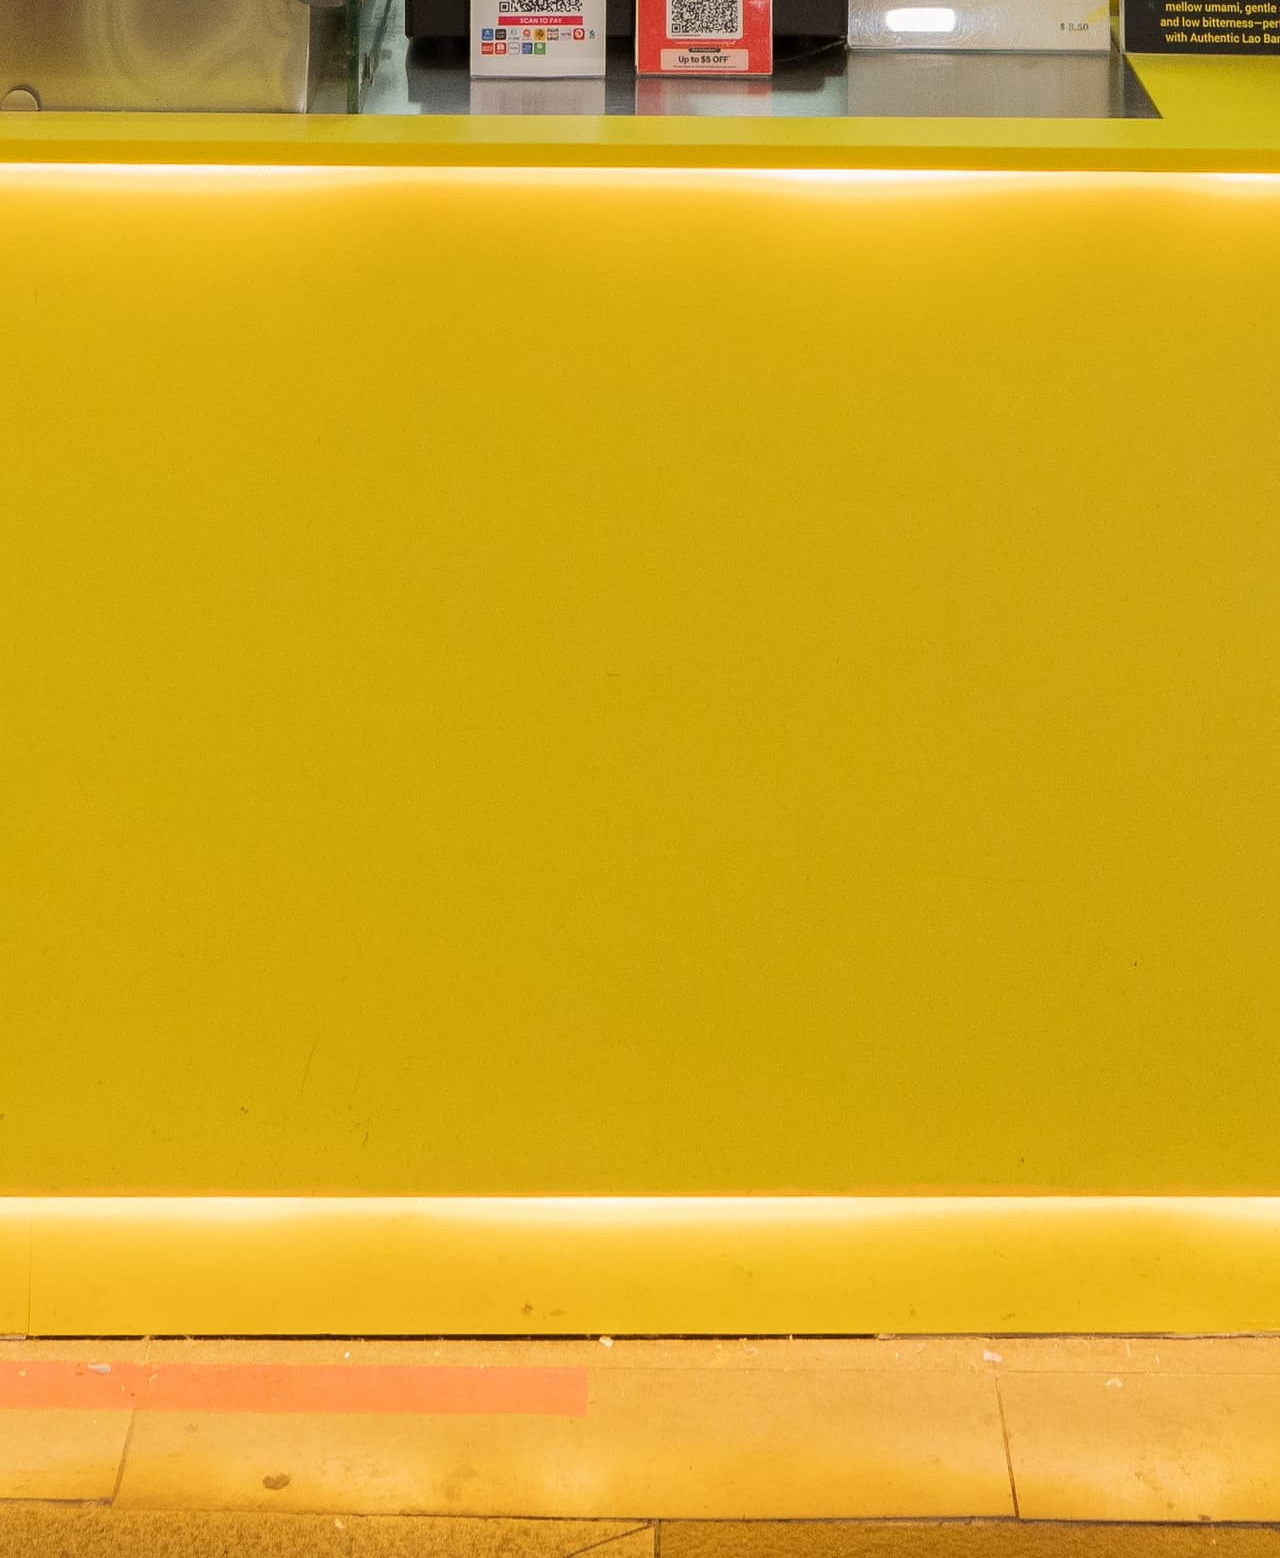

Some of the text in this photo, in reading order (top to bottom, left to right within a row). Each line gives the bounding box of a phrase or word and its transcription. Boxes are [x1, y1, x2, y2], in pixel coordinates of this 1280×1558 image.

[1165, 2, 1203, 13] mellow
[1205, 3, 1243, 15] umami,
[1245, 3, 1277, 15] gentle
[1160, 17, 1179, 27] and
[1182, 17, 1200, 27] low
[1166, 33, 1188, 43] with
[1190, 33, 1239, 43] Authentic
[1242, 34, 1261, 44] Lao
[679, 56, 689, 65] Up
[701, 55, 711, 64] $5
